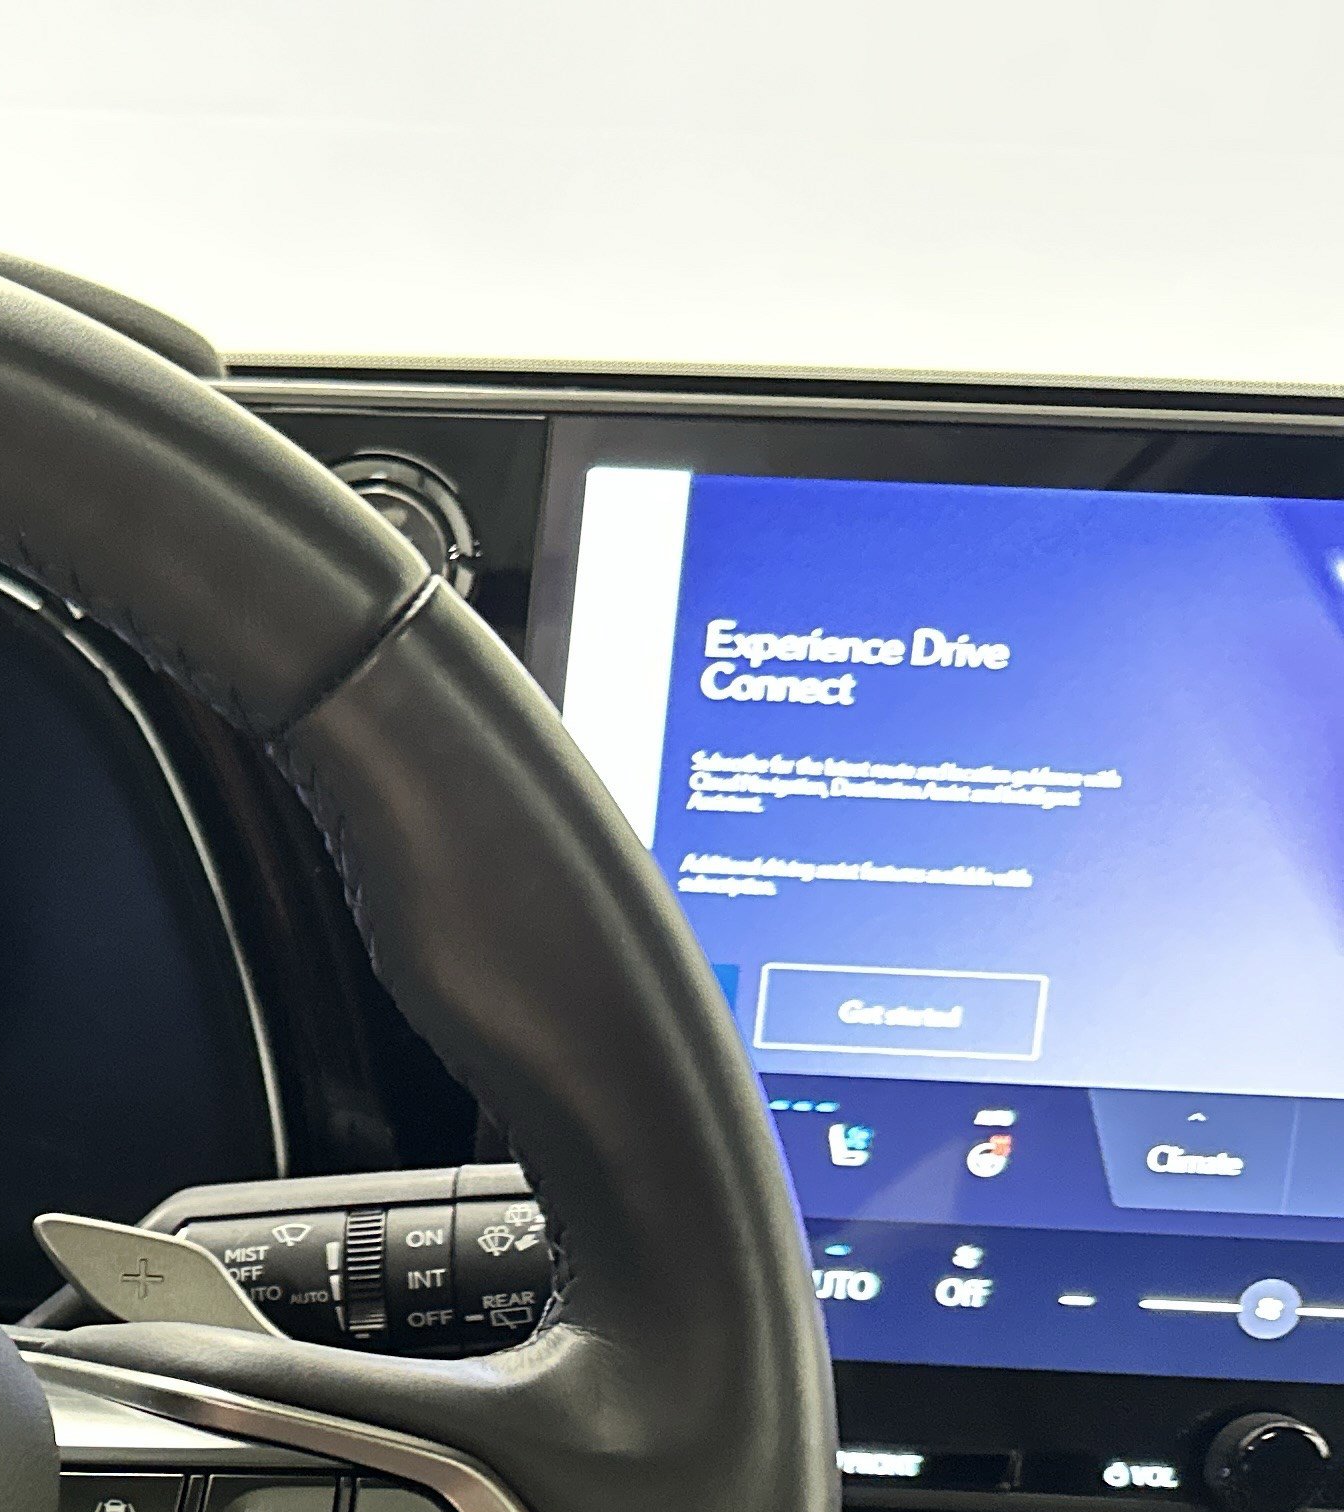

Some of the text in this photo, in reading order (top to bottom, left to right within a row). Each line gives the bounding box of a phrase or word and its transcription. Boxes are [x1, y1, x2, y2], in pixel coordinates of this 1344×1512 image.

[705, 619, 1010, 670] Experience Drive
[700, 662, 857, 706] Connect
[1146, 1144, 1244, 1176] Climate
[405, 1230, 444, 1248] ON
[224, 1244, 269, 1265] MIST
[228, 1265, 265, 1282] OFF
[408, 1268, 447, 1290] INT
[247, 1285, 329, 1305] UTO AUTO
[812, 1270, 882, 1300] UTO
[935, 1276, 994, 1308] Off
[482, 1290, 535, 1308] REAR
[407, 1309, 454, 1328] OFF
[1130, 1464, 1180, 1489] VOL
